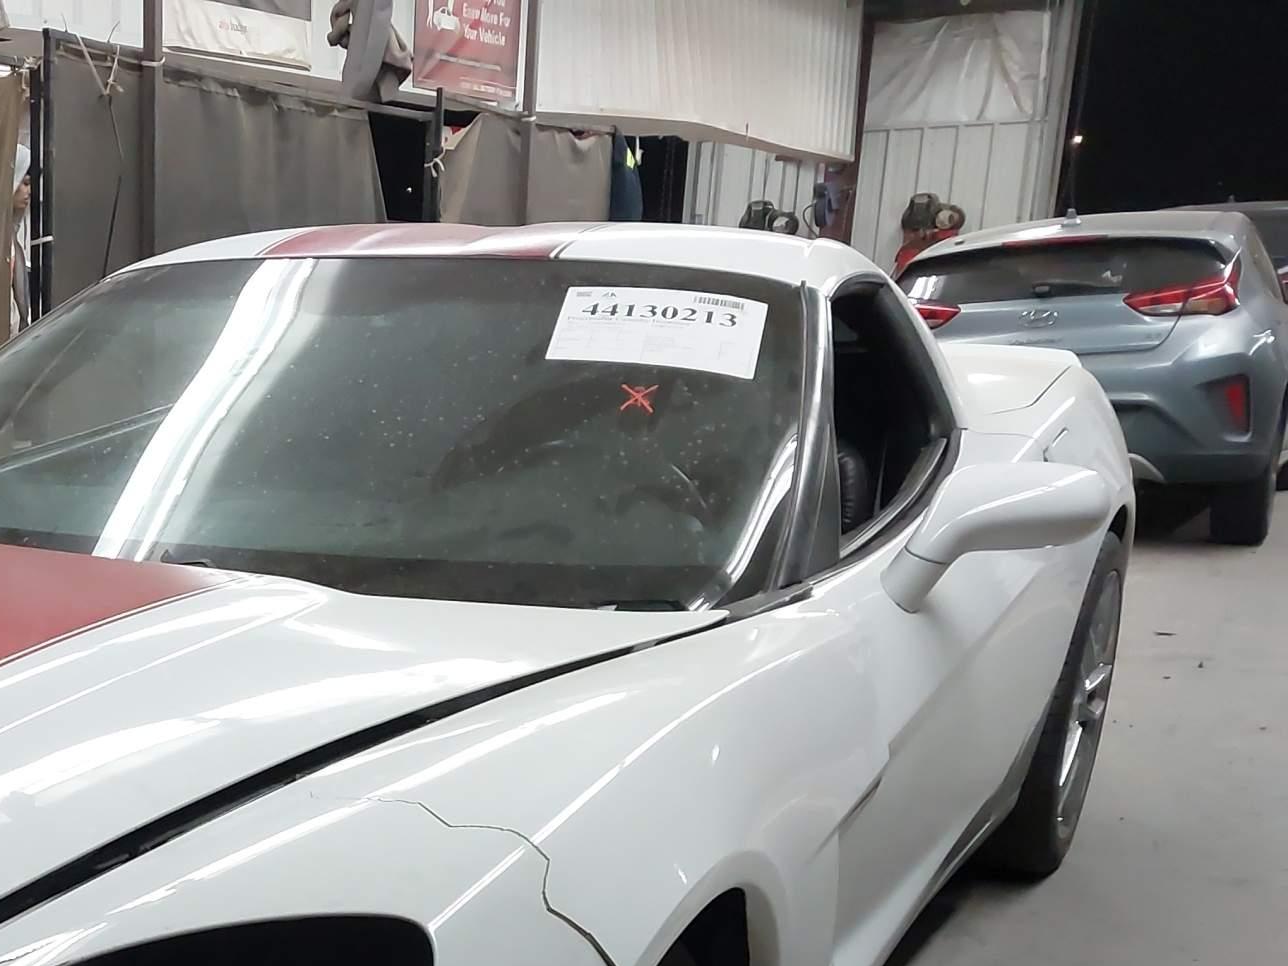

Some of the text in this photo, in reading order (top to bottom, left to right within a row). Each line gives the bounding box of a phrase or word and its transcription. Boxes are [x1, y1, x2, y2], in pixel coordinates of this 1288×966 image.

[463, 24, 506, 46] Your Vehicle
[582, 302, 737, 328] 44130213
